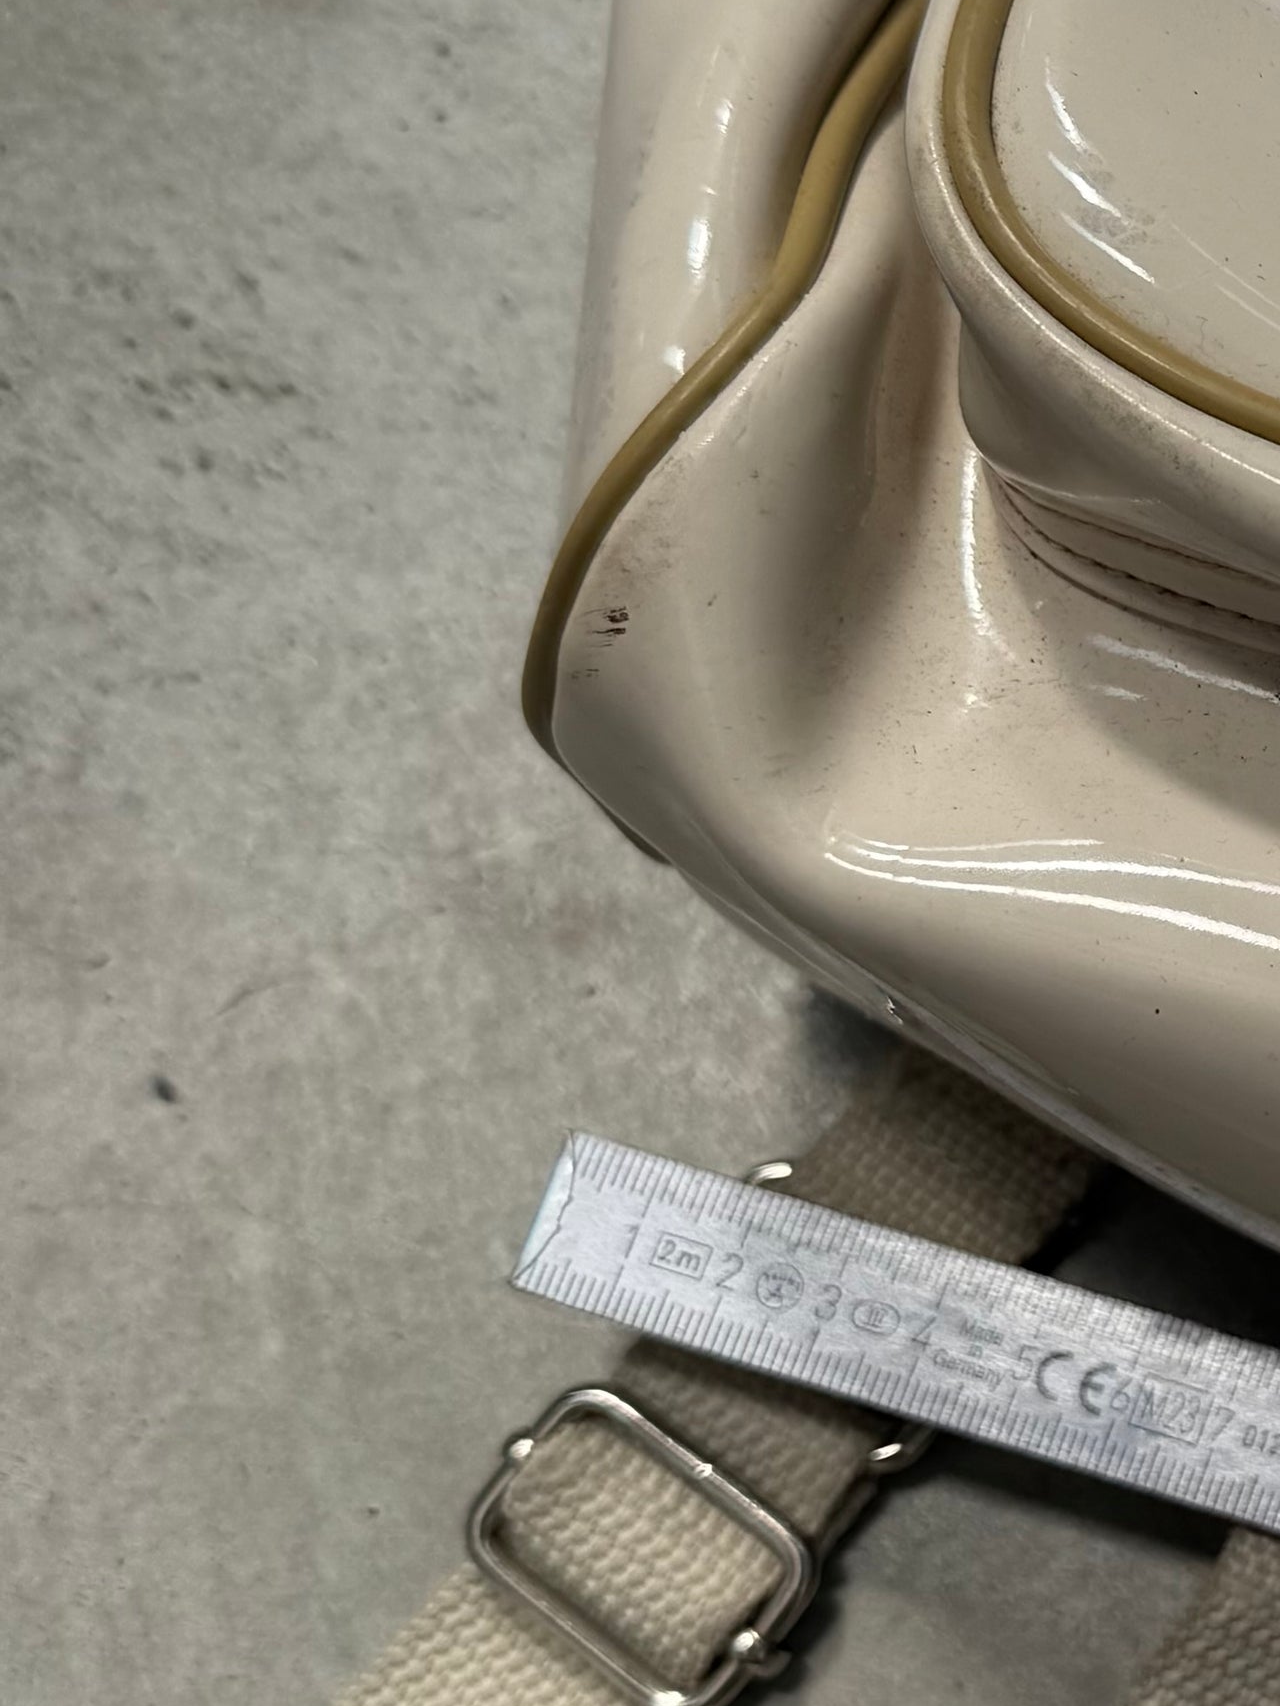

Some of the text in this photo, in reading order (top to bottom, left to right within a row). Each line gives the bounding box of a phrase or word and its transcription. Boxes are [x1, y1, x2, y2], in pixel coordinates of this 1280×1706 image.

[656, 1238, 701, 1273] 2m
[715, 1251, 744, 1291] 2
[815, 1283, 843, 1322] 3
[910, 1315, 937, 1352] 4
[1109, 1377, 1133, 1411] 6
[1211, 1405, 1237, 1442] 7
